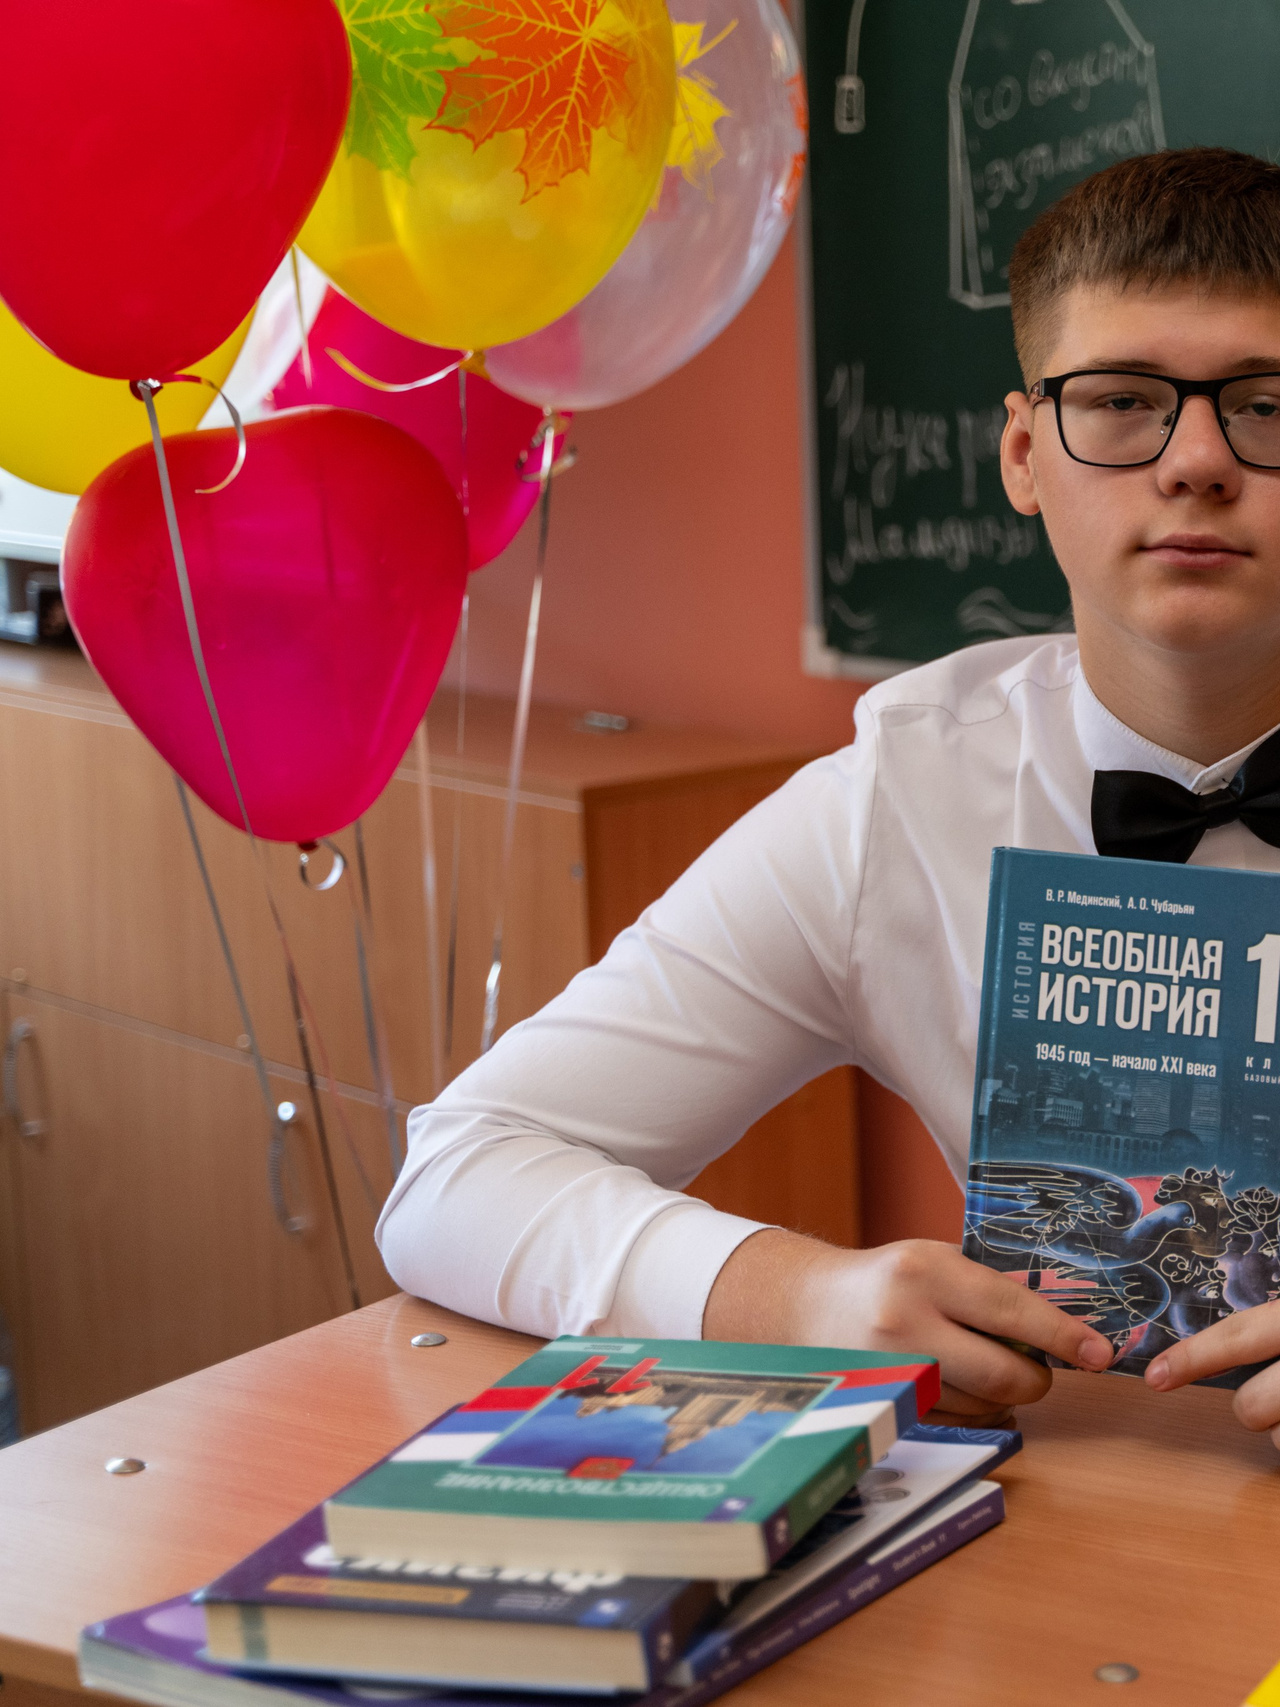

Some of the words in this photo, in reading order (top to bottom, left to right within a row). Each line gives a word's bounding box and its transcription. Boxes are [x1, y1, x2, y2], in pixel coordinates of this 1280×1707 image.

[1046, 888, 1055, 902] В.
[1057, 890, 1065, 903] Р.
[1067, 891, 1123, 910] Мединский,
[1127, 896, 1137, 910] А.
[1139, 897, 1149, 911] О.
[1151, 899, 1195, 915] Чубарьян
[1011, 921, 1036, 1020] ИСТОРИЯ
[1041, 923, 1224, 983] ВСЕОБЩАЯ
[1037, 972, 1221, 1039] ИСТОРИЯ
[1035, 1042, 1066, 1062] 1945
[1068, 1049, 1091, 1067] год
[1112, 1054, 1157, 1073] начало
[1160, 1055, 1183, 1074] XXI
[1186, 1062, 1217, 1078] века
[552, 1355, 662, 1393] 11
